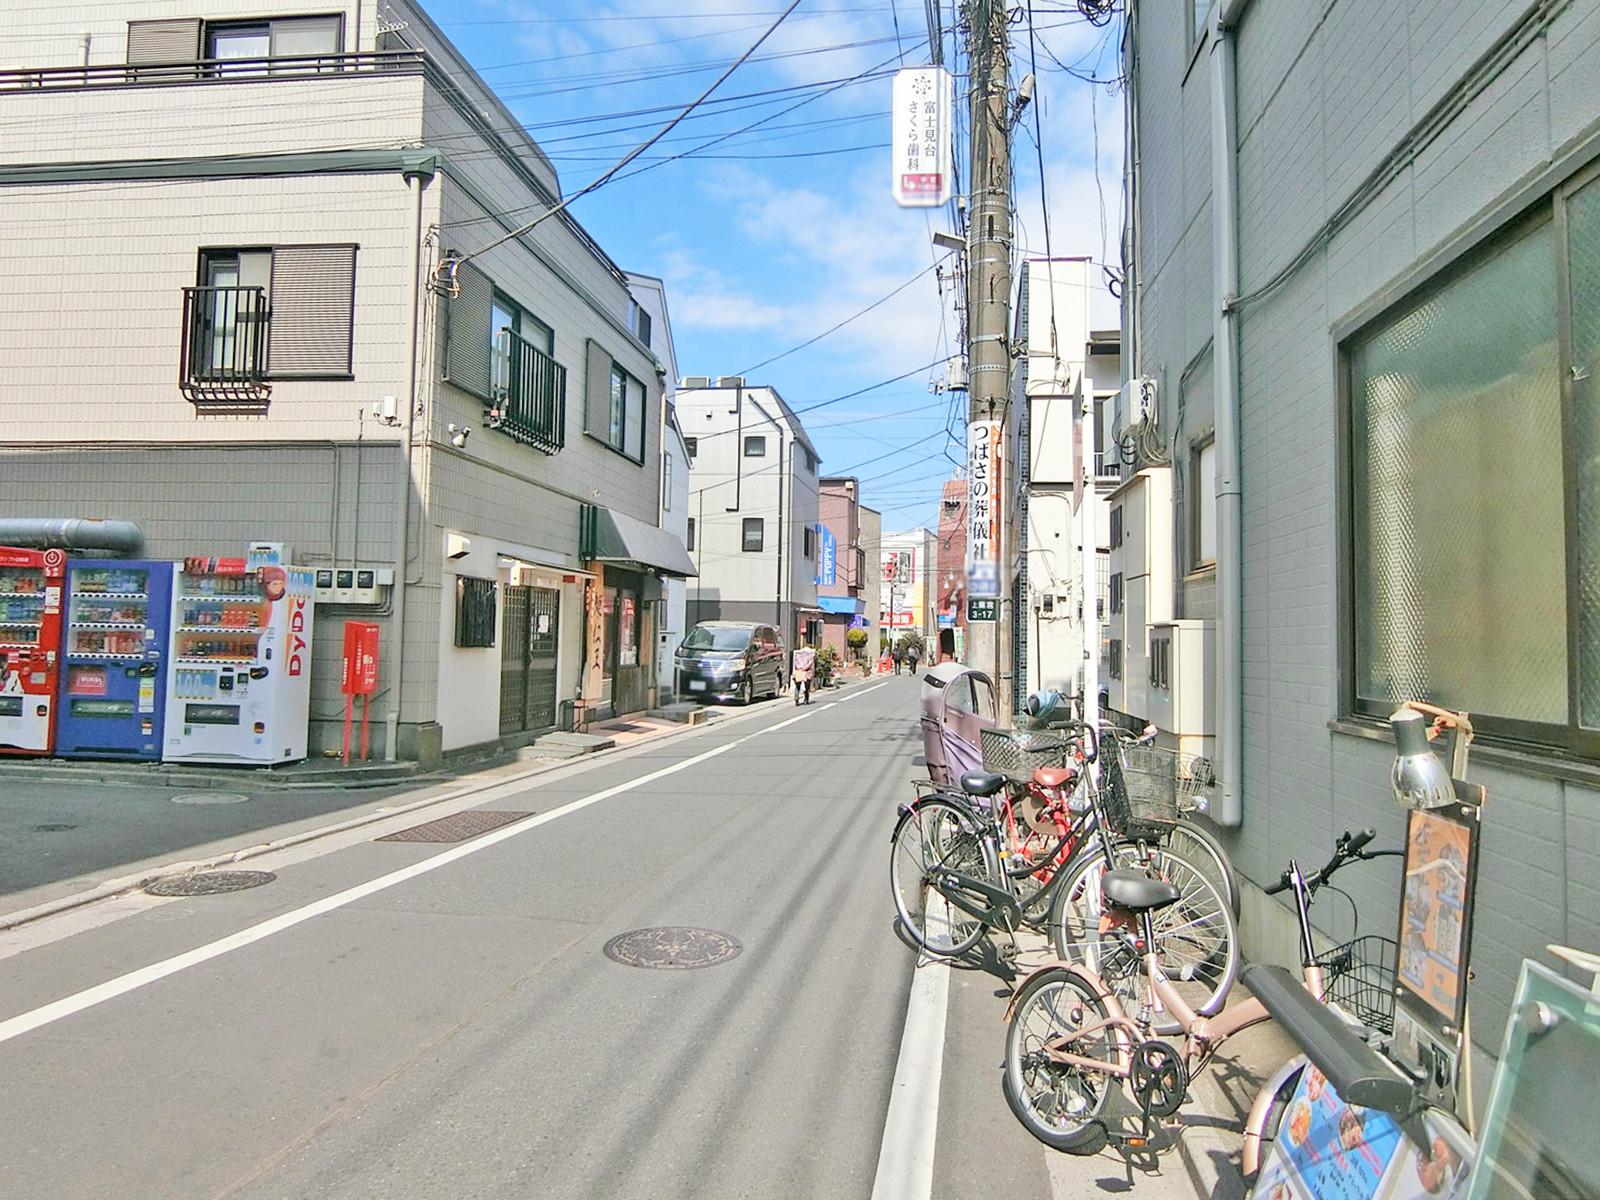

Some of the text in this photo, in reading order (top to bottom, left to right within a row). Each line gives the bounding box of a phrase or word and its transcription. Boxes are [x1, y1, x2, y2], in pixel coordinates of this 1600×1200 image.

[907, 101, 919, 171] さくら歯科
[924, 101, 936, 157] 富士見台
[973, 425, 989, 561] つばさの葬儀社
[824, 547, 833, 575] POPPY
[972, 610, 993, 619] 3-17
